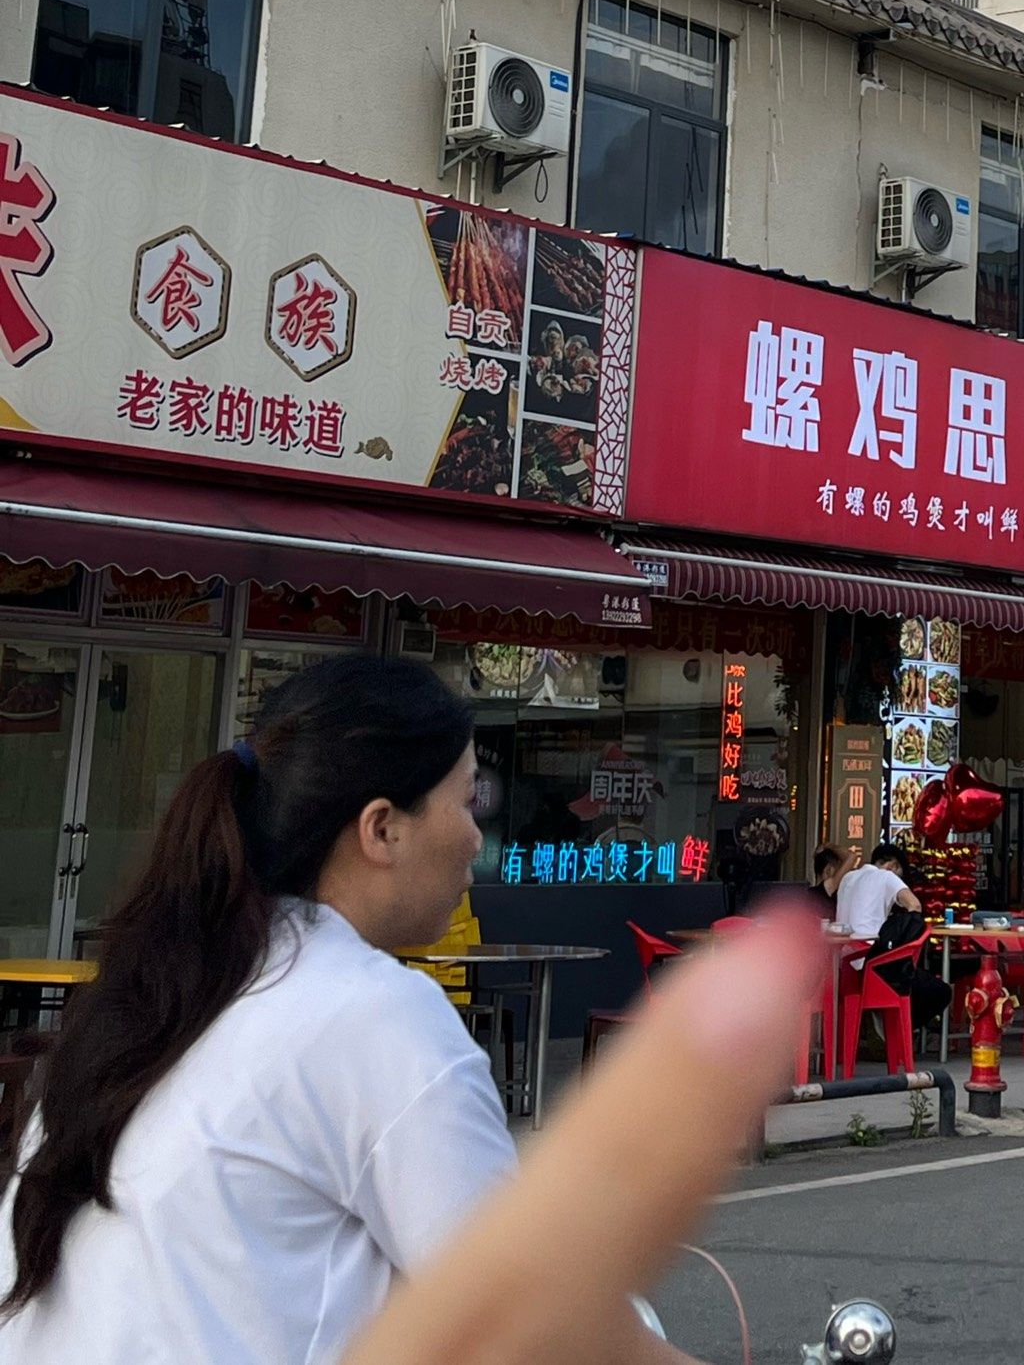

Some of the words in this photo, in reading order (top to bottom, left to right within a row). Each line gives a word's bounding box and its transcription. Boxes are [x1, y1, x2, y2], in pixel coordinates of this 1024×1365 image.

[447, 302, 512, 347] 自贡
[439, 355, 508, 395] 烧烤
[117, 369, 347, 458] 老家的味道
[590, 770, 654, 803] 周年庆
[503, 834, 711, 884] 有螺的鸡煲才叫鲜
